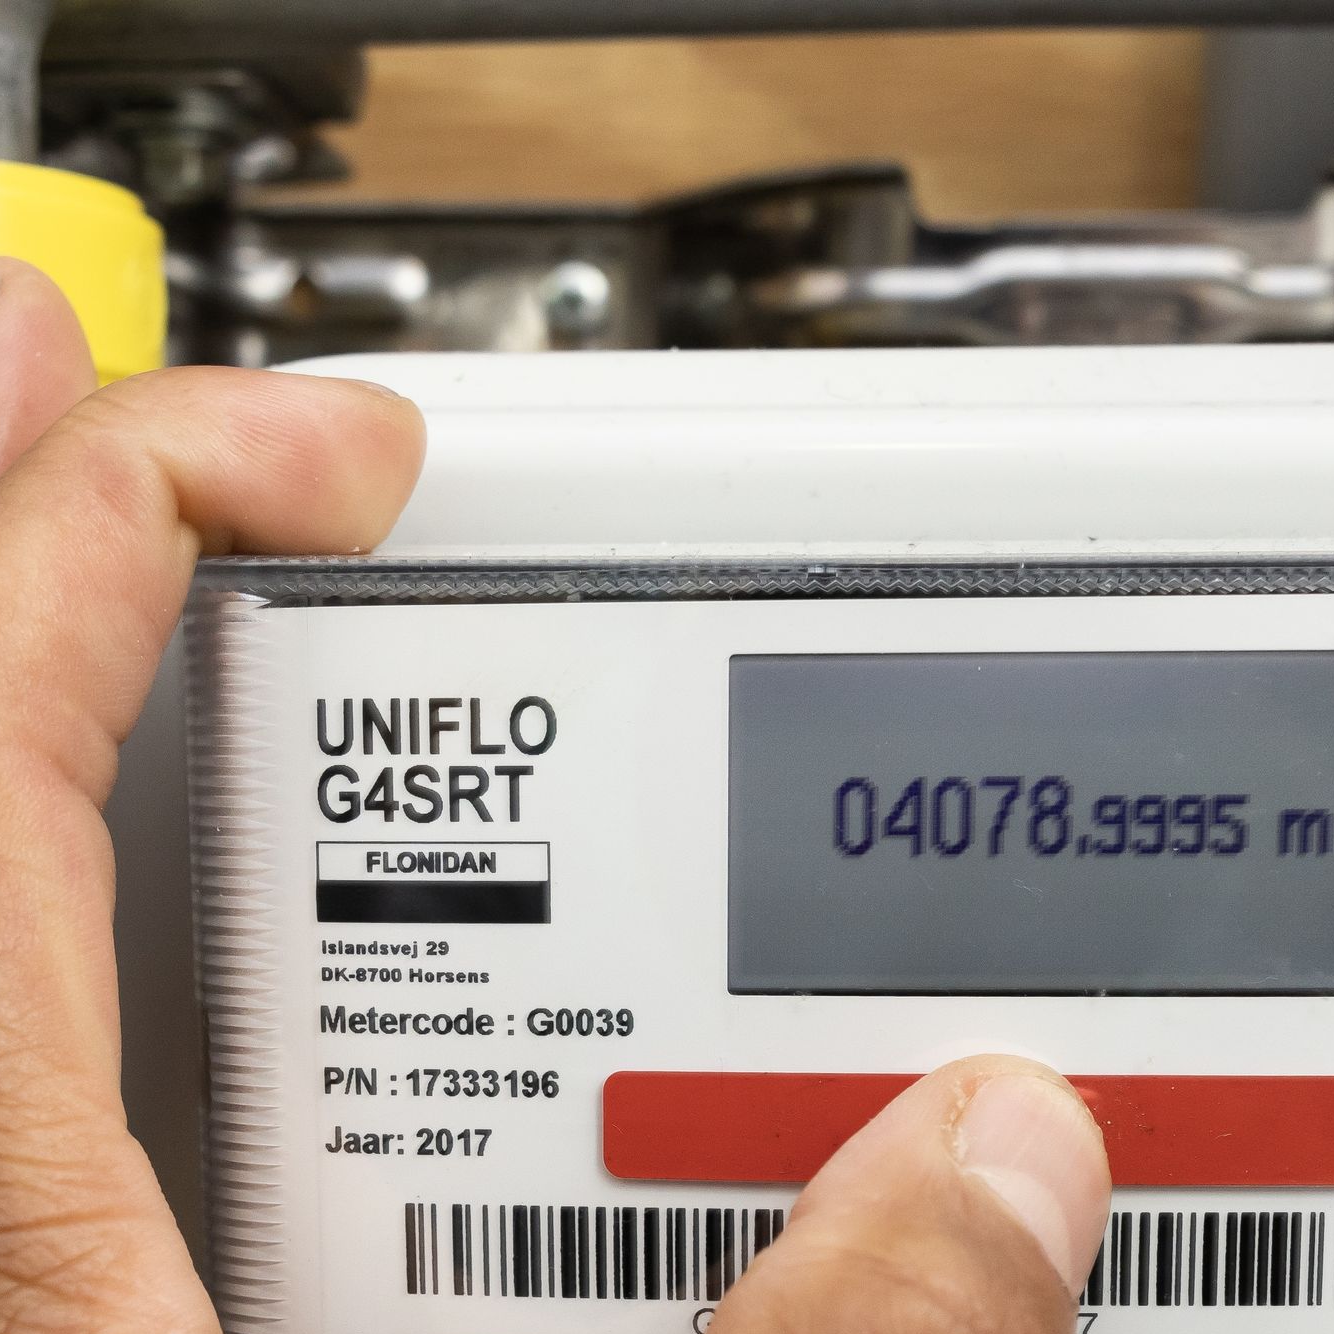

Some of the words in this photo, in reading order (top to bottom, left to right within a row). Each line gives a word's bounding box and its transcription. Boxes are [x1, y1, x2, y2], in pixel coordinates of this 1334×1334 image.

[316, 695, 558, 757] UNIFLO
[316, 764, 534, 824] G4SRT
[366, 851, 497, 874] FLONIDAN
[321, 939, 418, 959] Islandsvej
[425, 940, 450, 956] 29
[321, 966, 403, 983] DK-8700
[408, 968, 490, 984] Horsens
[320, 1005, 495, 1036] Metercode
[526, 1007, 635, 1037] G0039
[323, 1066, 378, 1096] P/N
[324, 1125, 405, 1155] Jaar:
[415, 1127, 493, 1157] 2017
